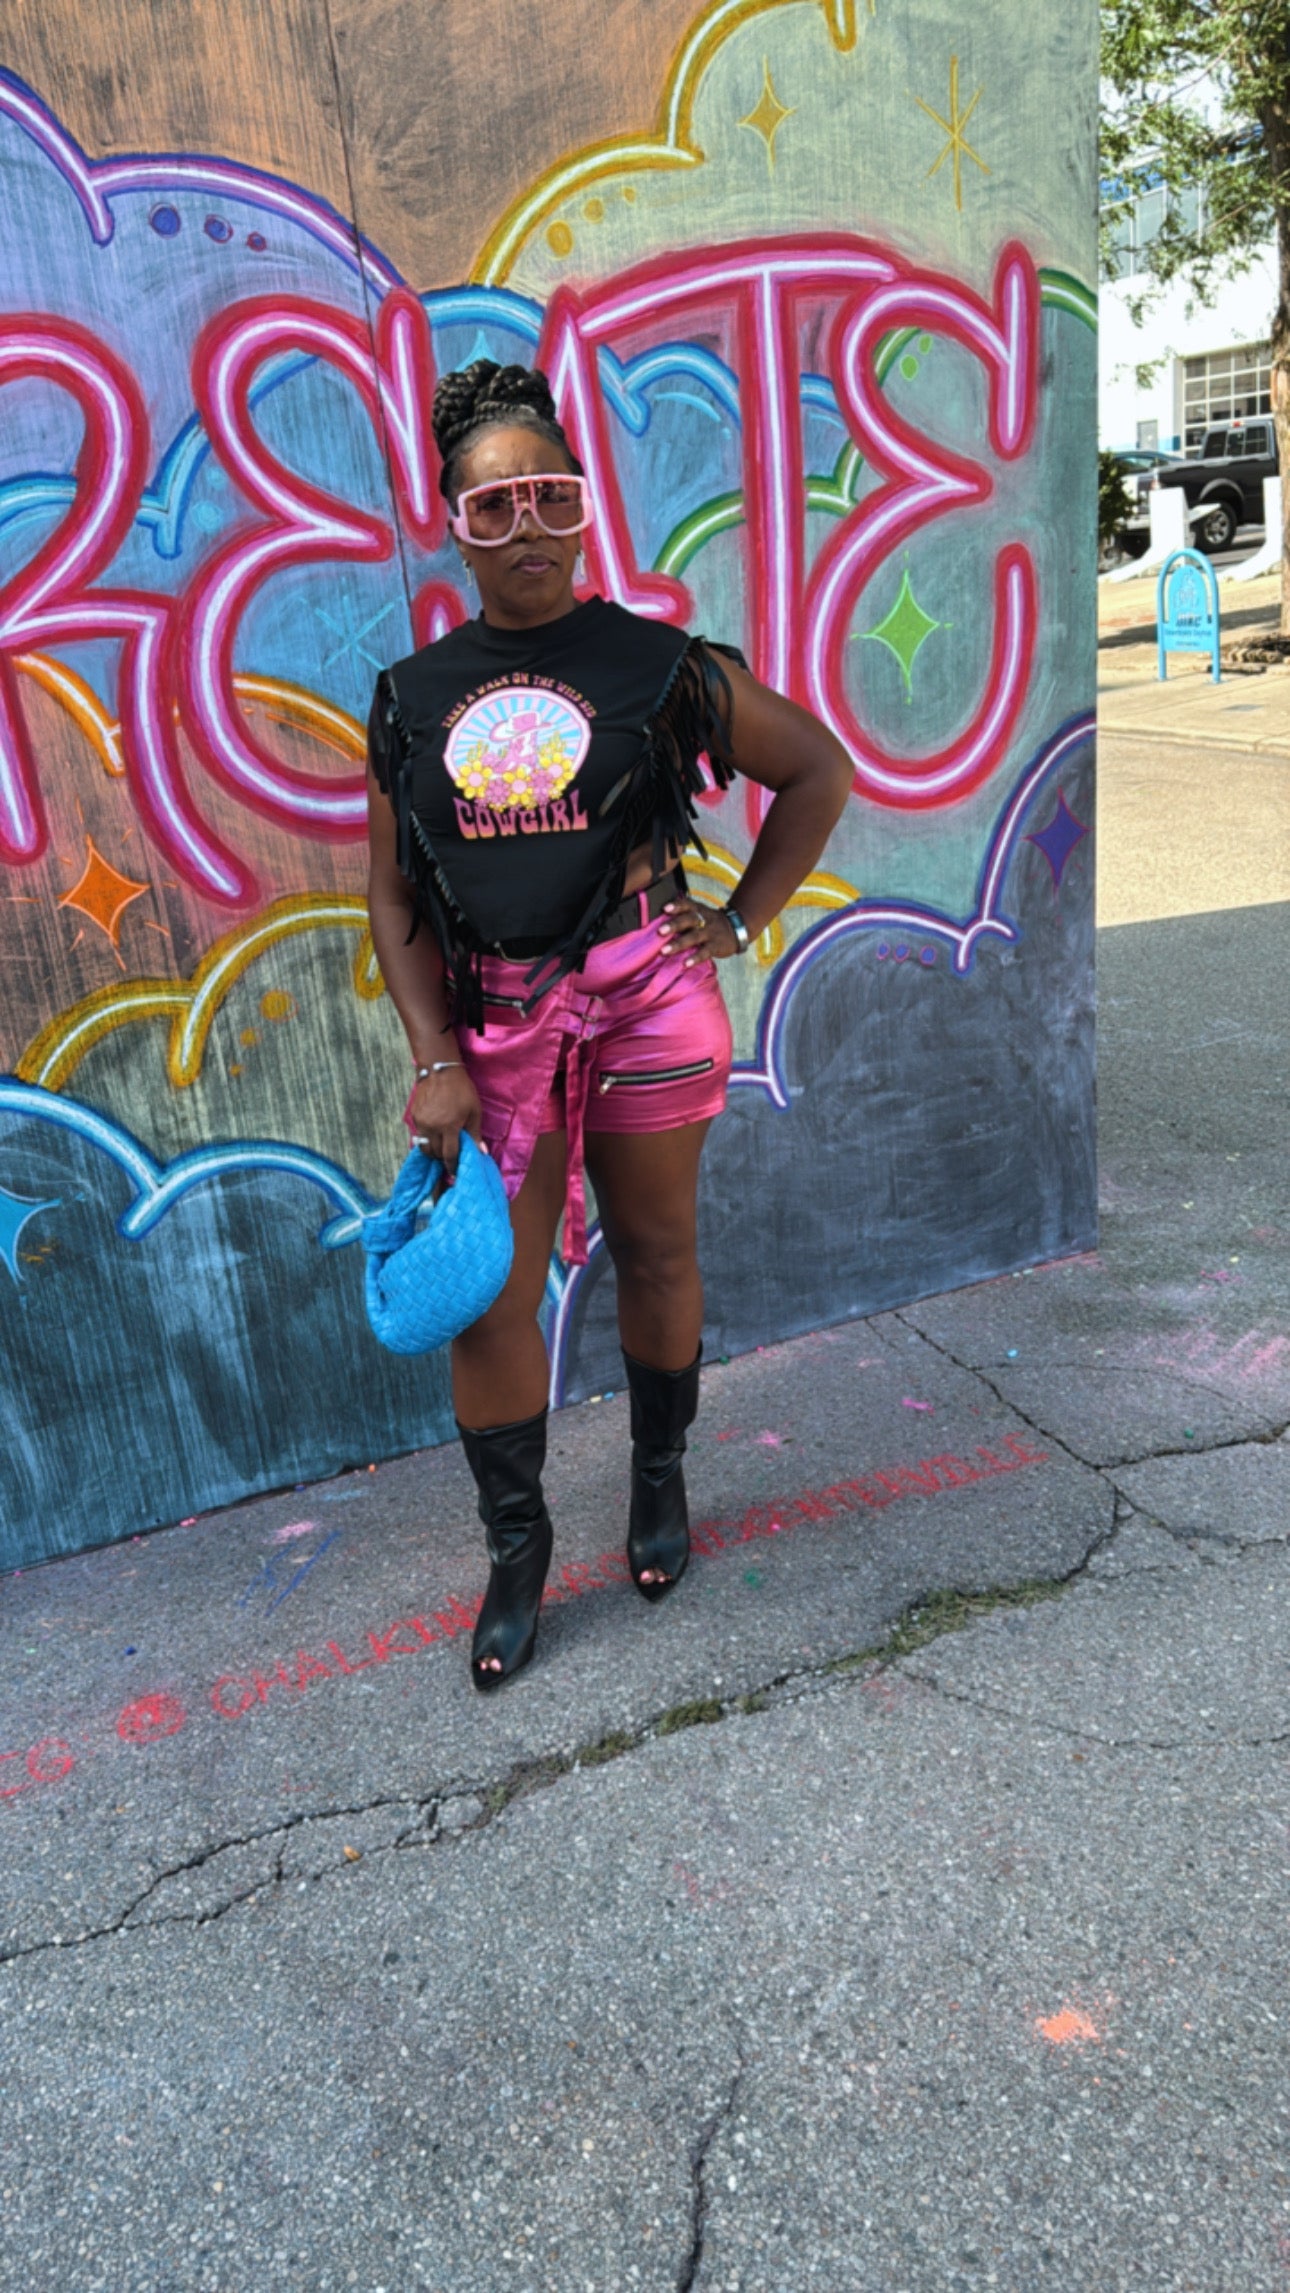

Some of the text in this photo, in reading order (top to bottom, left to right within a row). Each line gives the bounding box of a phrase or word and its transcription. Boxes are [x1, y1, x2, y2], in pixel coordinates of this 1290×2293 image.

[464, 691, 476, 705] A
[476, 674, 510, 696] WALK
[511, 671, 530, 685] ON
[532, 674, 556, 689] THE
[453, 788, 589, 841] COWGIRL
